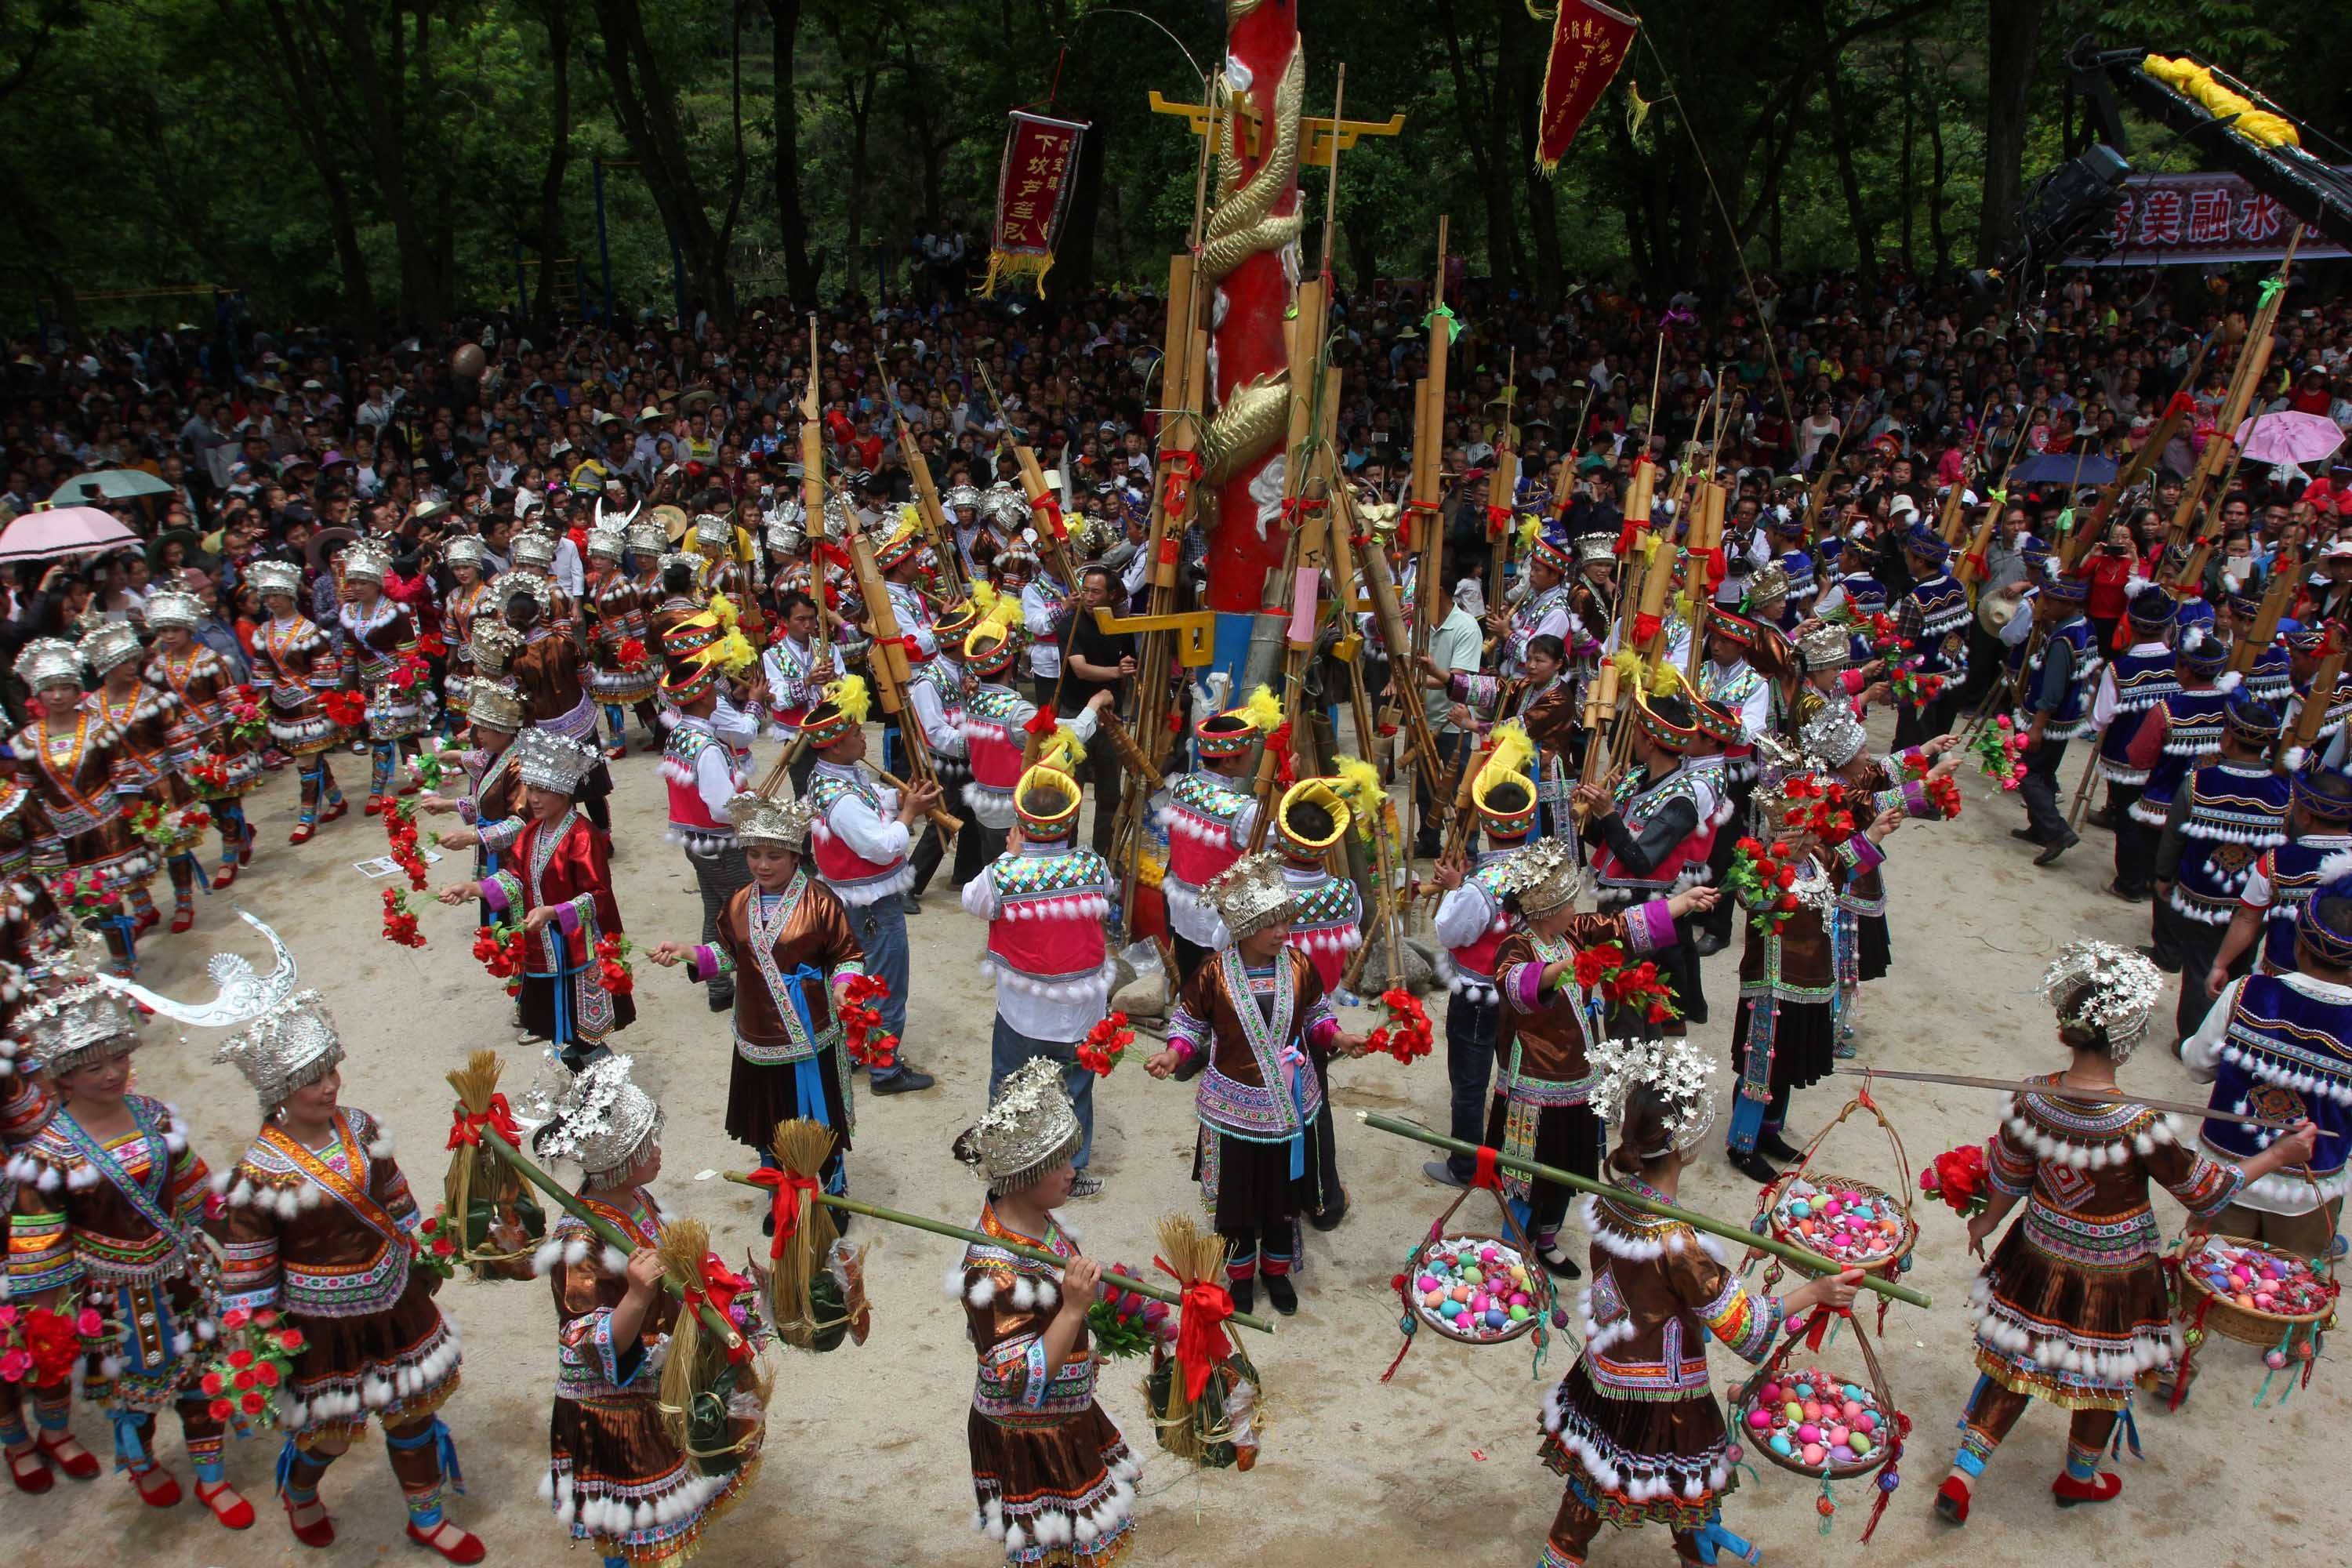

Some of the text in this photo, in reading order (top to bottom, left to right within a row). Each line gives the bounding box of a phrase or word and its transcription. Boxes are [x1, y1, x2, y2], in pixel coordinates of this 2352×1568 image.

[1003, 134, 1058, 241] 下坎芦笙队
